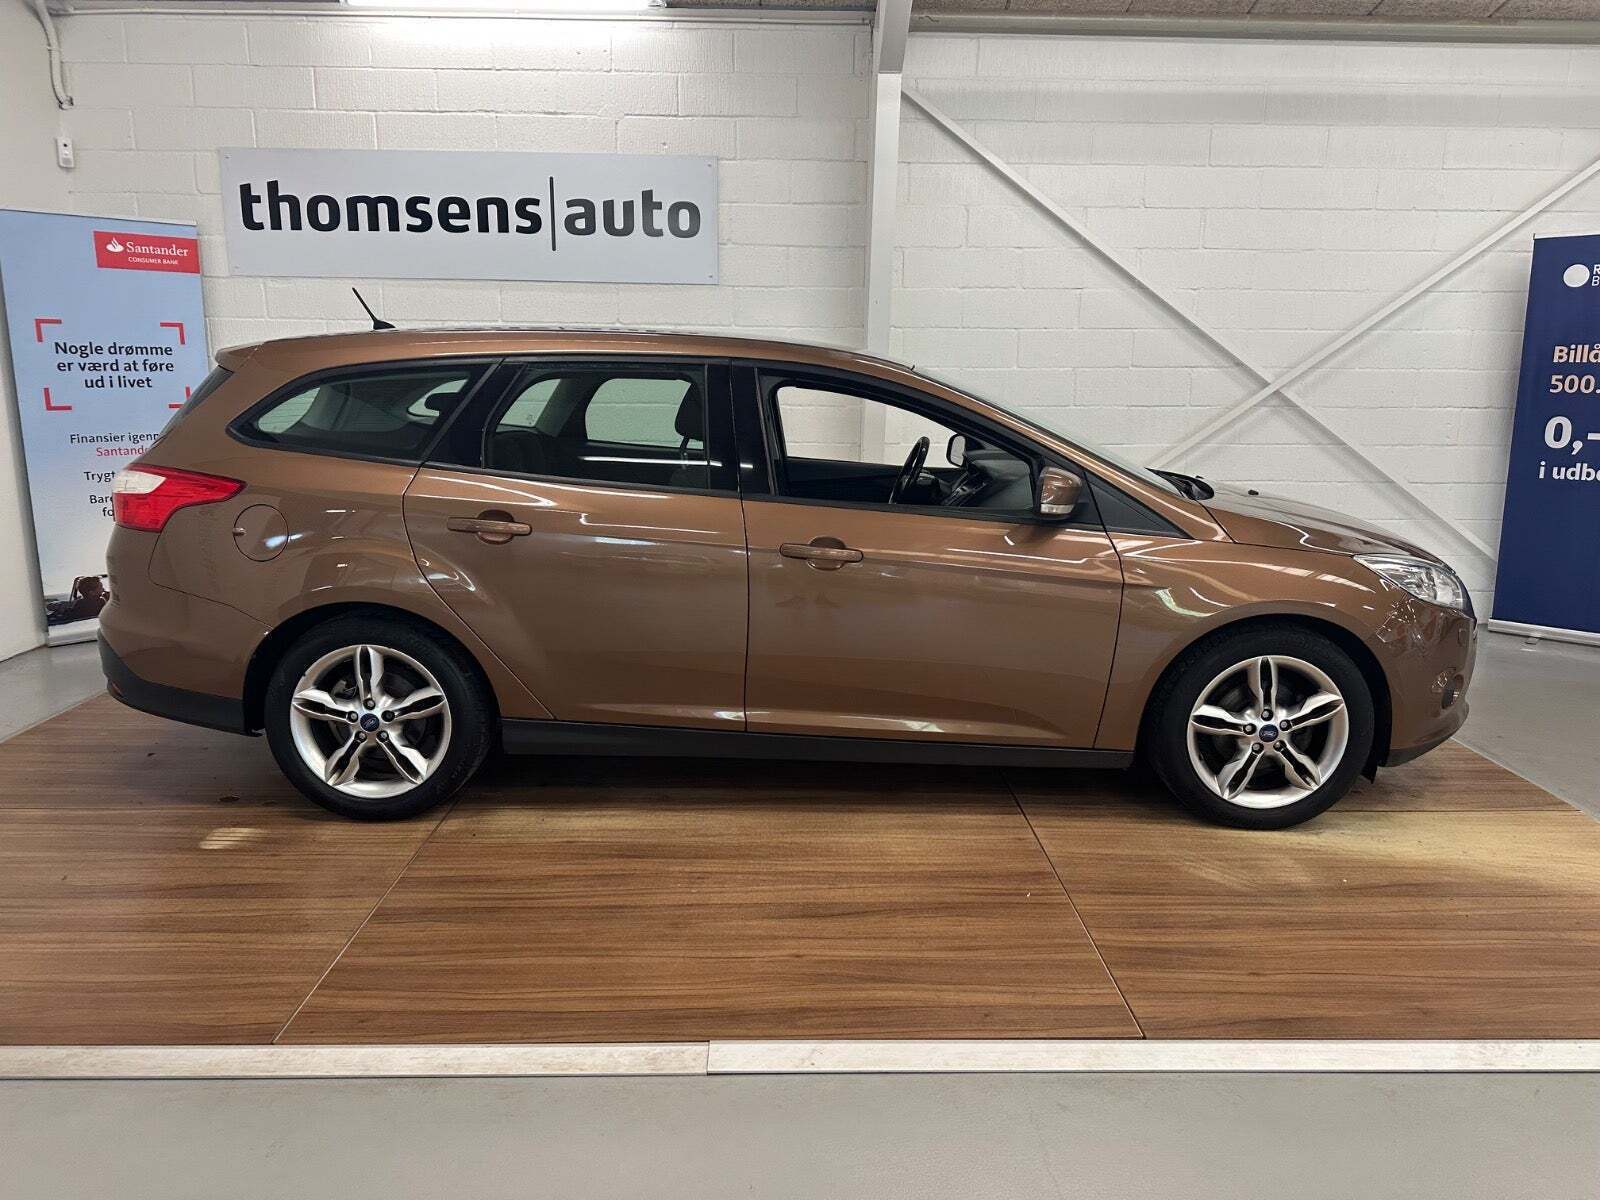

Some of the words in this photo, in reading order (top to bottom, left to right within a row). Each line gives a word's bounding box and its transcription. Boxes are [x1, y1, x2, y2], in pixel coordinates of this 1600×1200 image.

[239, 179, 543, 234] thomsens
[563, 189, 701, 239] auto
[126, 241, 189, 257] Santander
[128, 256, 162, 264] CONSUMER
[54, 341, 104, 359] Nogle
[107, 341, 173, 356] drømme
[56, 361, 74, 372] er
[78, 359, 119, 372] værd
[123, 359, 139, 372] at
[142, 359, 174, 373] føre
[84, 375, 105, 389] ud
[108, 375, 114, 388] i
[117, 375, 153, 389] livet
[1549, 374, 1600, 394] 500.
[70, 433, 126, 444] Finansier
[83, 470, 116, 483] Trygt
[1538, 460, 1546, 479] i
